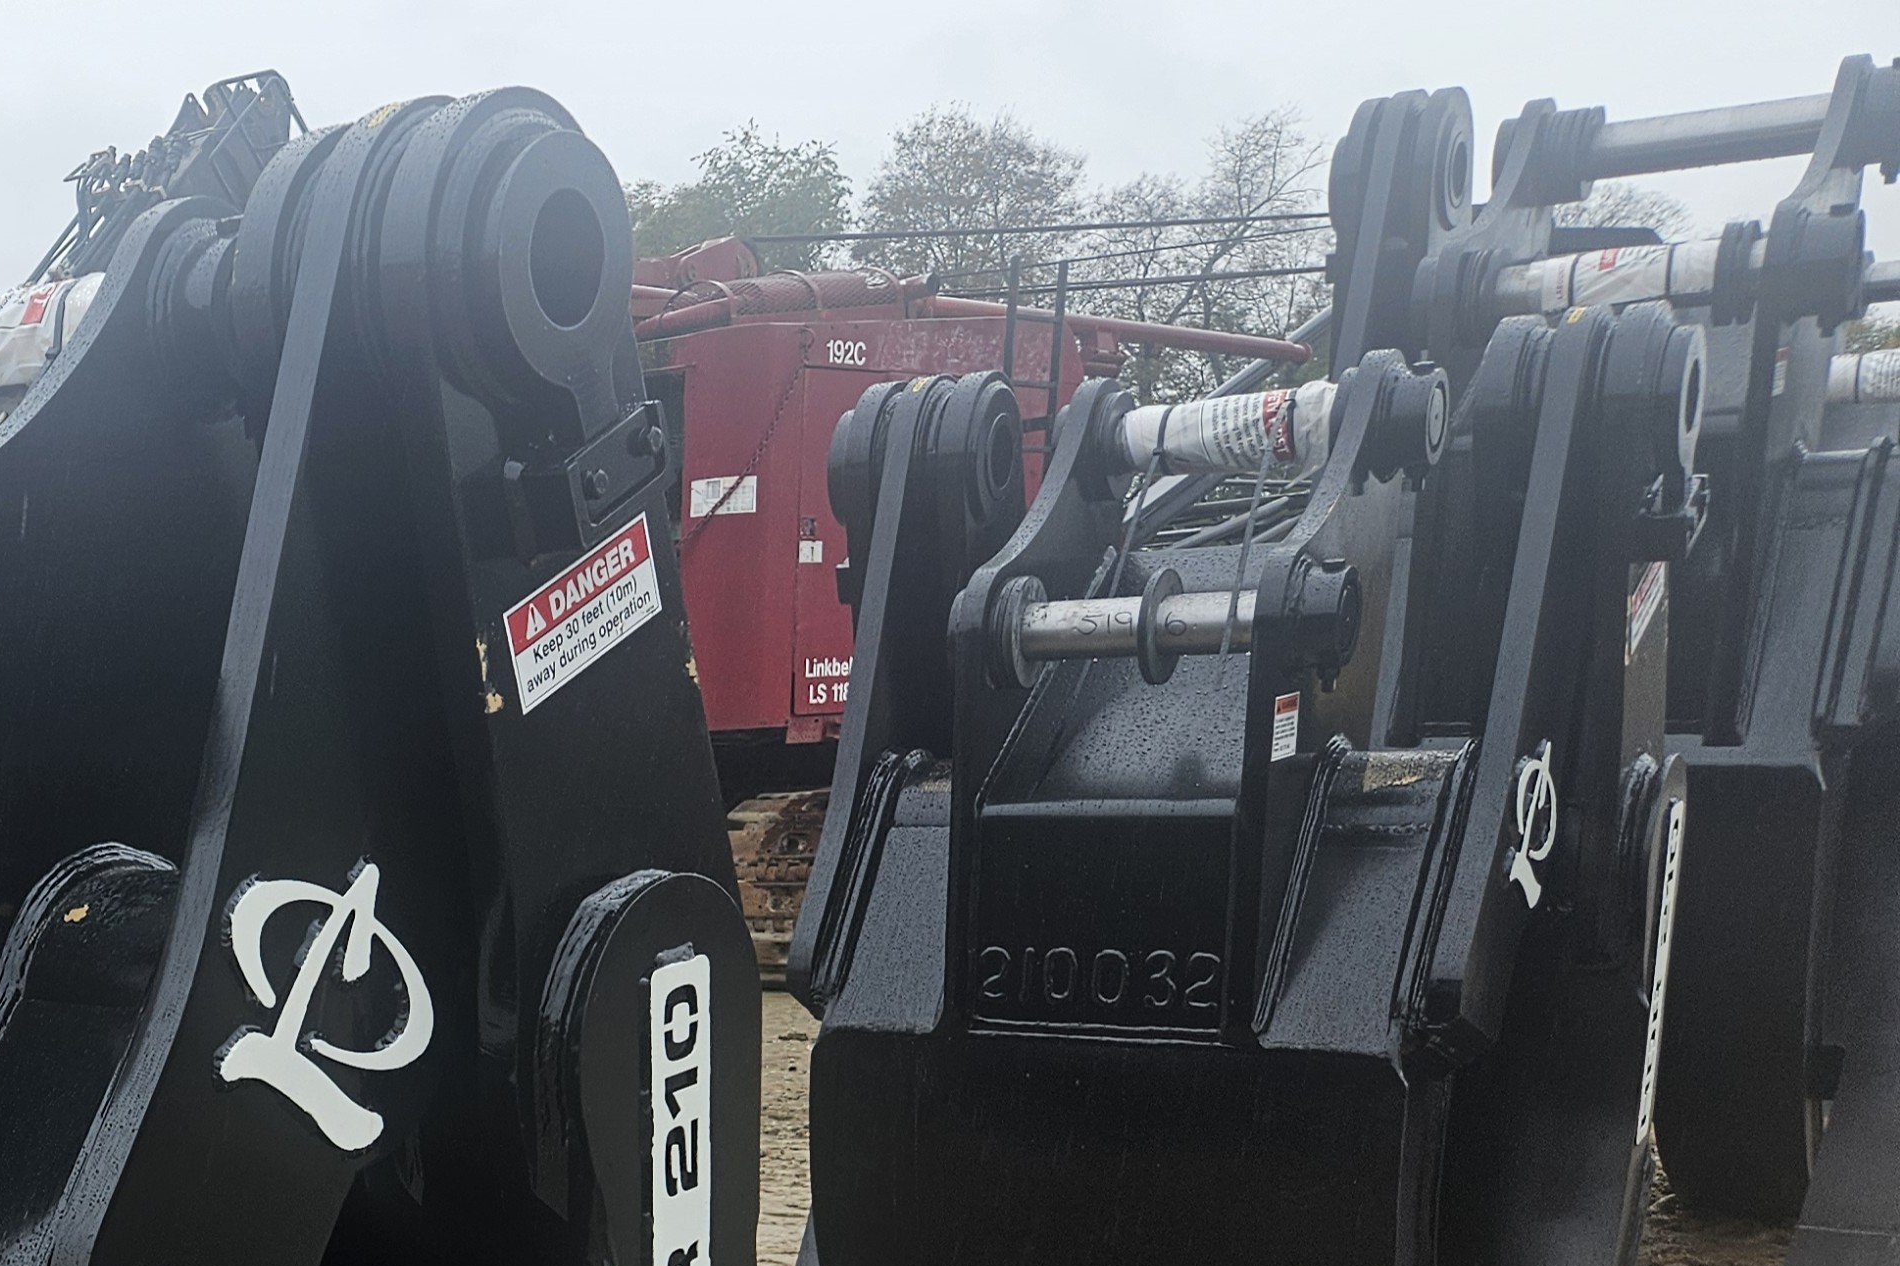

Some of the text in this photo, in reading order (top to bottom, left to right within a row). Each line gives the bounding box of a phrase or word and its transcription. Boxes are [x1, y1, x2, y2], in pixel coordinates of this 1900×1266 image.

[826, 339, 867, 366] 192C
[548, 537, 636, 621] DANGER
[527, 591, 651, 693] away during operation
[532, 574, 638, 664] Keep 30 feet (10m)
[805, 656, 854, 678] Linkbel
[809, 683, 827, 704] LS
[980, 946, 1221, 1007] 210032
[663, 983, 699, 1201] 210
